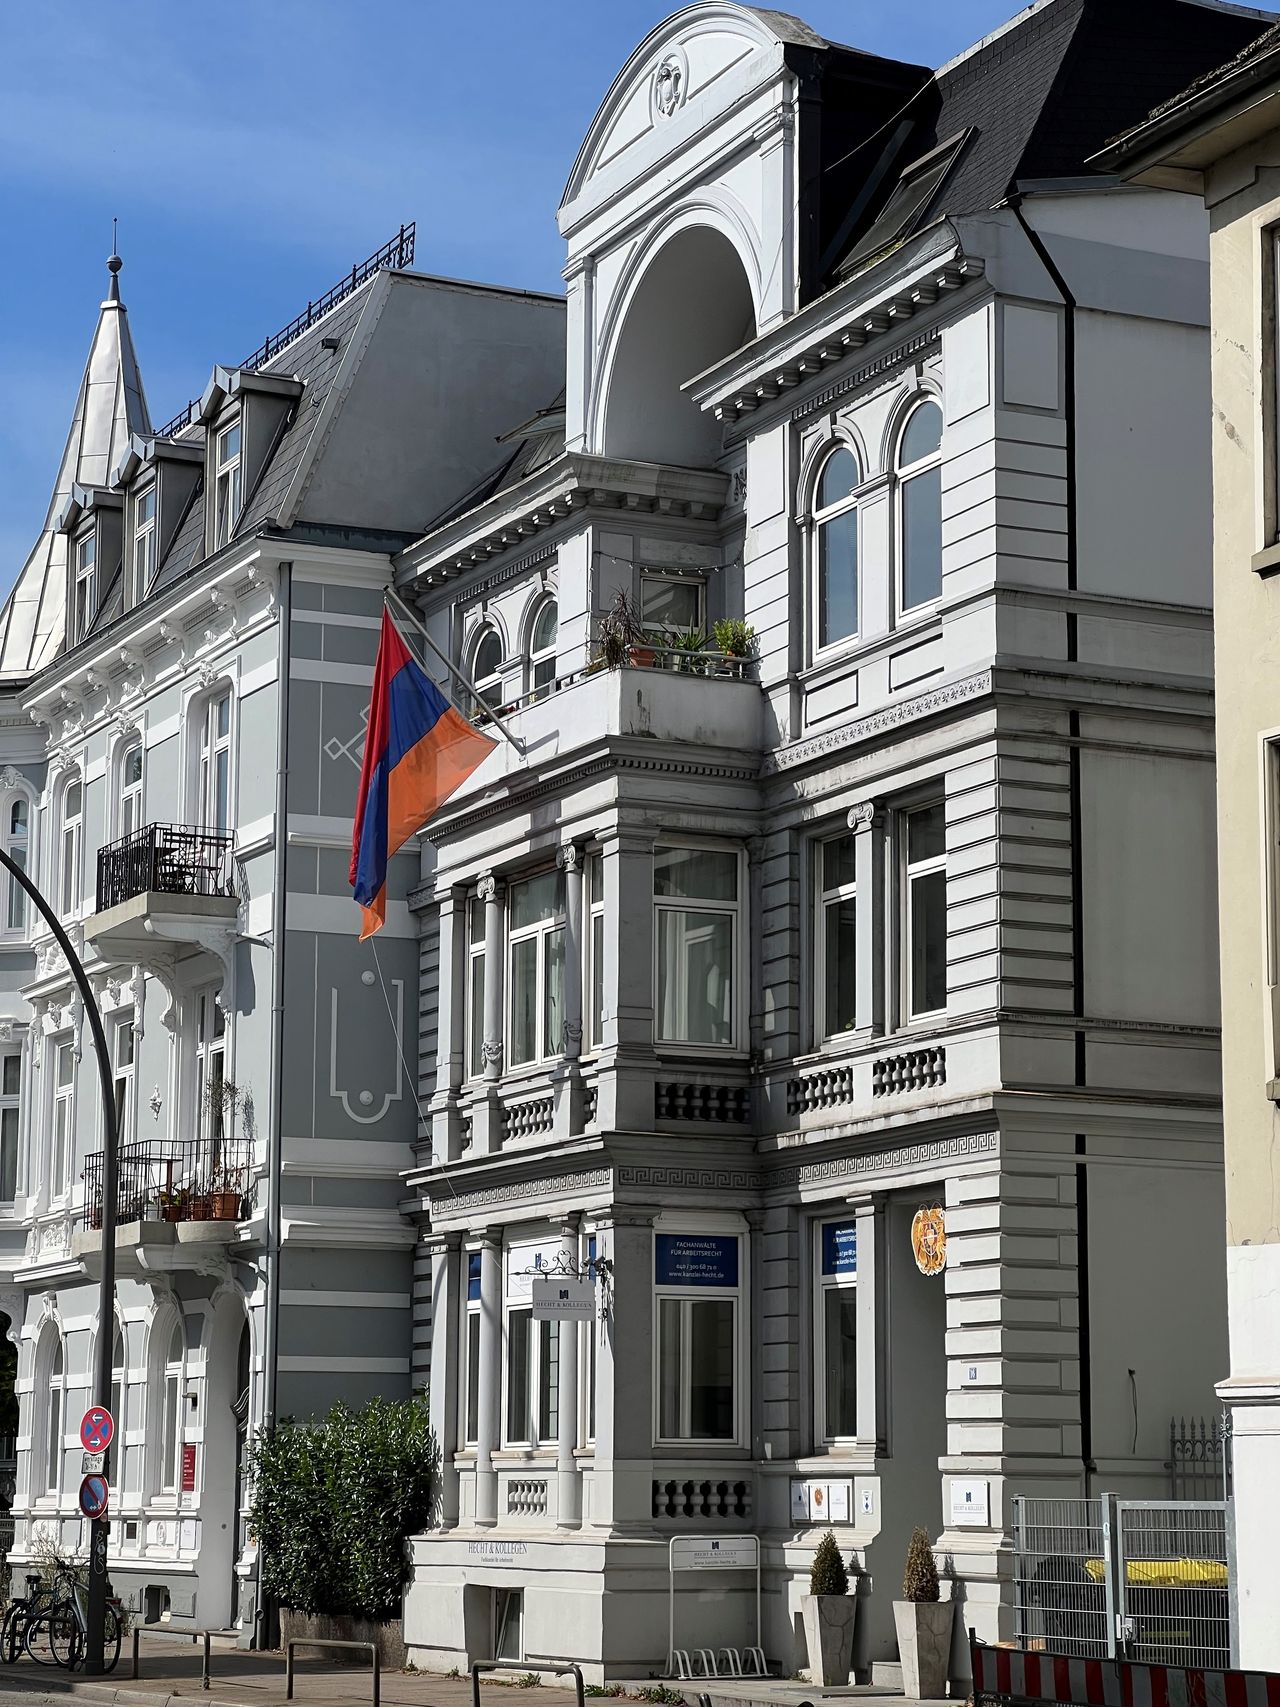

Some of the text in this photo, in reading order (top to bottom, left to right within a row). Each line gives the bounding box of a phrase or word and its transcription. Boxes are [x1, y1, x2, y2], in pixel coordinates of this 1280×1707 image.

[676, 1241, 717, 1249] FACHANWÄLTE
[668, 1271, 725, 1279] www.kanzlei-hecht.de
[468, 1542, 528, 1555] HECHT & KOLLEGEN
